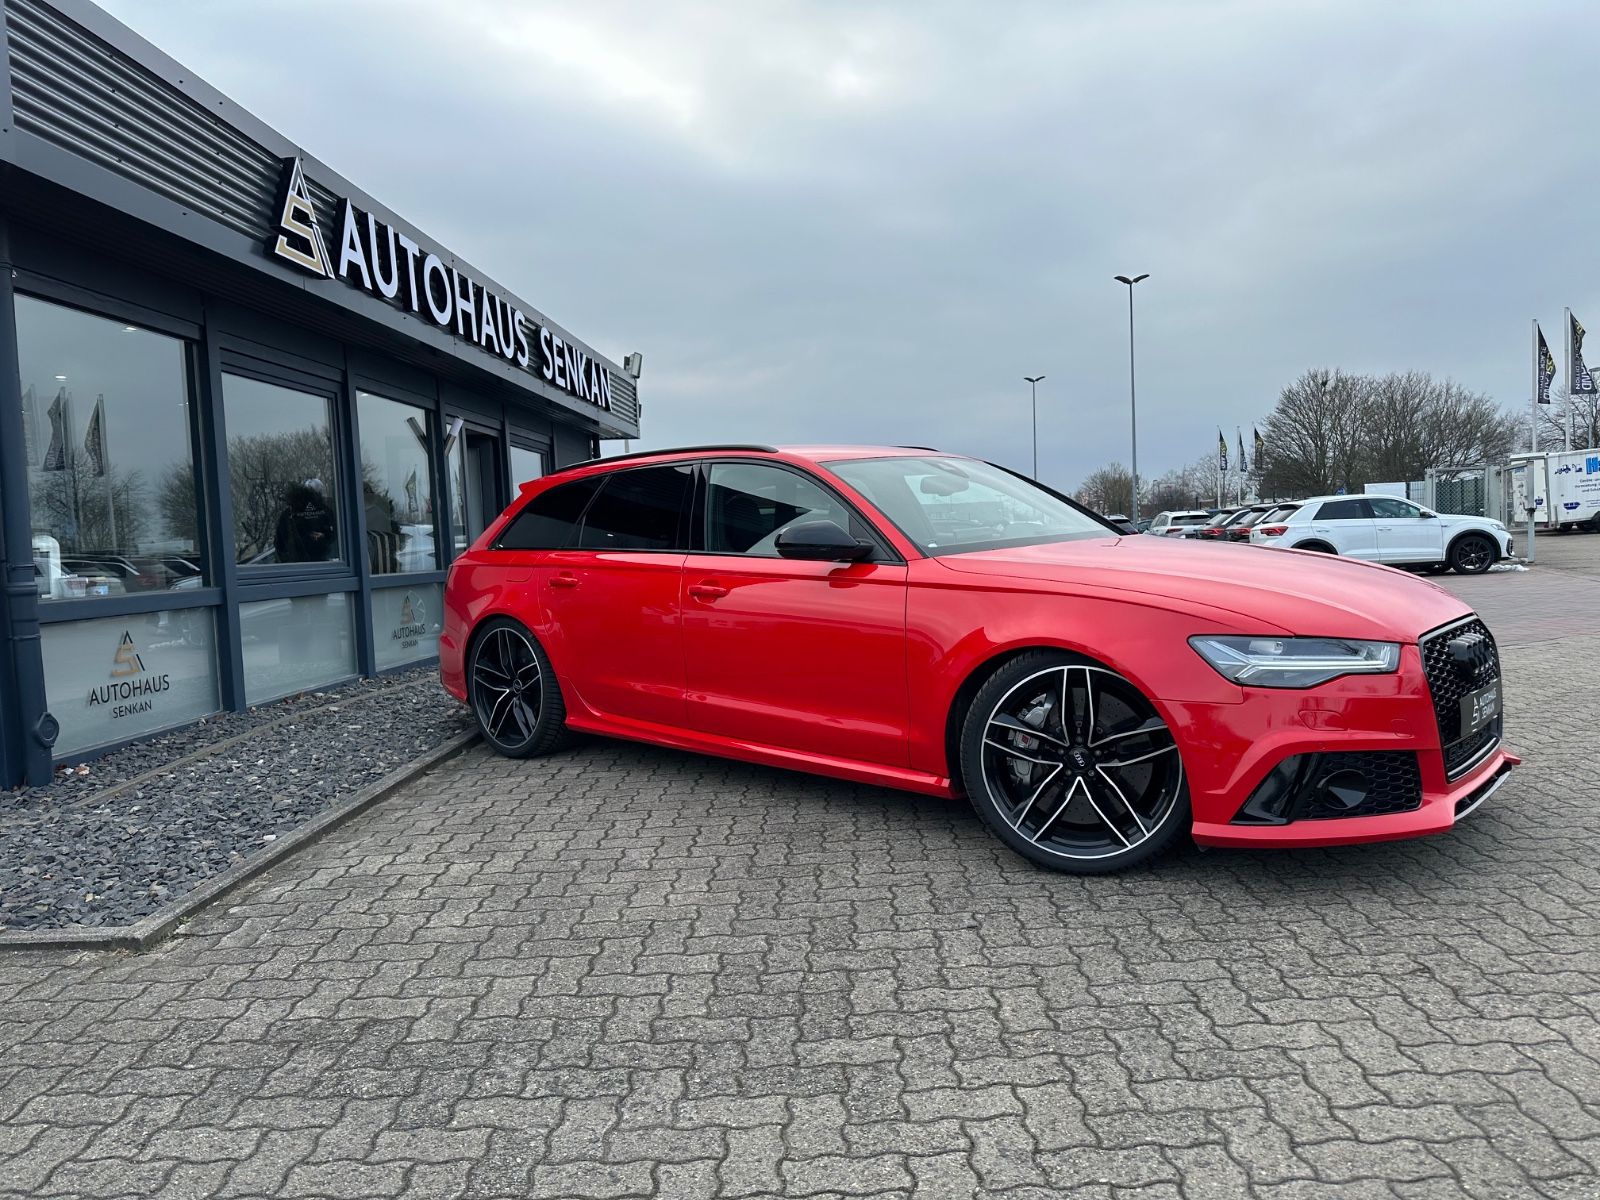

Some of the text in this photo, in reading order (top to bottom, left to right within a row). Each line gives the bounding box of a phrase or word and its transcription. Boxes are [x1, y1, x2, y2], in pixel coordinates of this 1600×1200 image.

[338, 196, 613, 412] AUTOHAUS SENKAN
[392, 623, 426, 641] AUTOHAUS
[89, 674, 170, 707] AUTOHAUS
[112, 700, 152, 719] SENKAN
